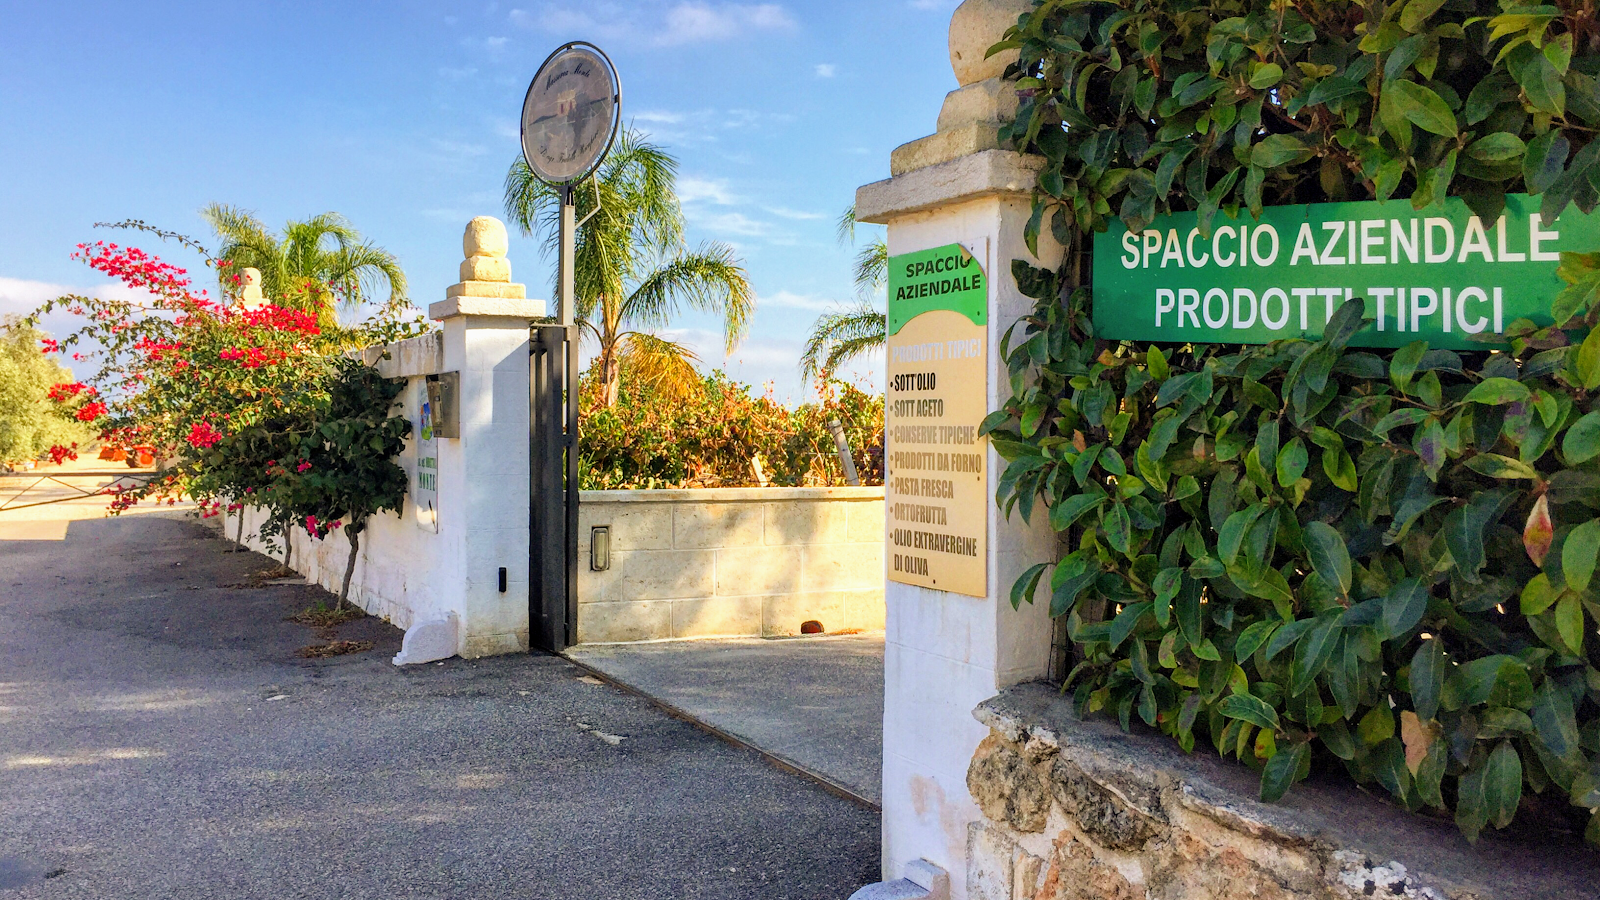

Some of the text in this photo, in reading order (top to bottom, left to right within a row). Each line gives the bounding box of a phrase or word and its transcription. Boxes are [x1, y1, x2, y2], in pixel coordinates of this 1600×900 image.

[1120, 213, 1561, 269] SPACCIO AZIENDALE
[906, 254, 973, 278] SPACCIO
[896, 274, 981, 301] AZIENDALE
[1155, 286, 1504, 334] PRODOTT TIPICI
[892, 339, 981, 363] PRODOTTI TIPICI
[894, 372, 936, 392] SOTT'OLIO
[894, 425, 975, 445] CONSERVE TIPICHE
[894, 452, 982, 474] PRODOTTI DA FORNO
[894, 478, 954, 499] PASTA FRESCA
[894, 502, 947, 526] ORTOFRUTTA
[894, 528, 977, 557] OLIO EXTRAVERGINE
[894, 553, 929, 577] DI OLIVA
